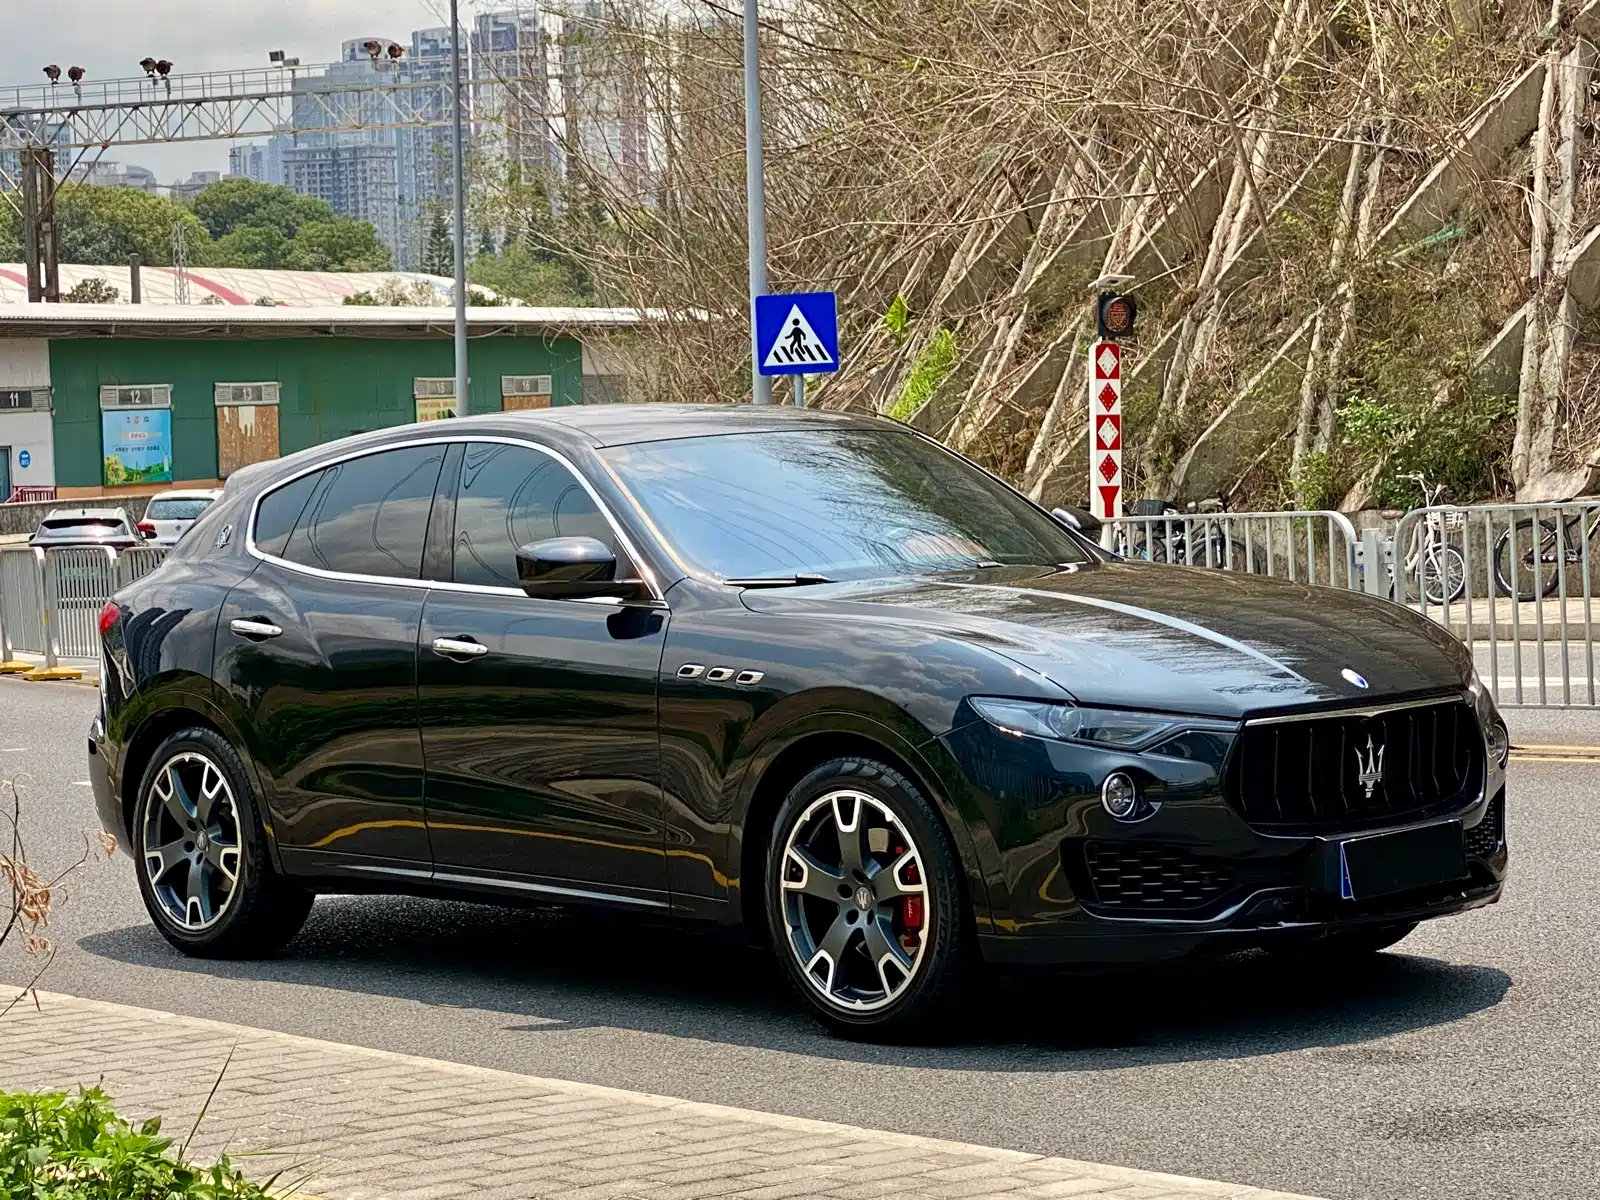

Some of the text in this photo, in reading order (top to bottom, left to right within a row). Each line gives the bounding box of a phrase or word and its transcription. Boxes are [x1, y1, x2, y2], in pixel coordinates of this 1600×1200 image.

[437, 382, 445, 394] 15
[522, 379, 530, 391] 16
[9, 392, 19, 407] 11
[130, 389, 141, 403] 12
[243, 387, 252, 400] 13
